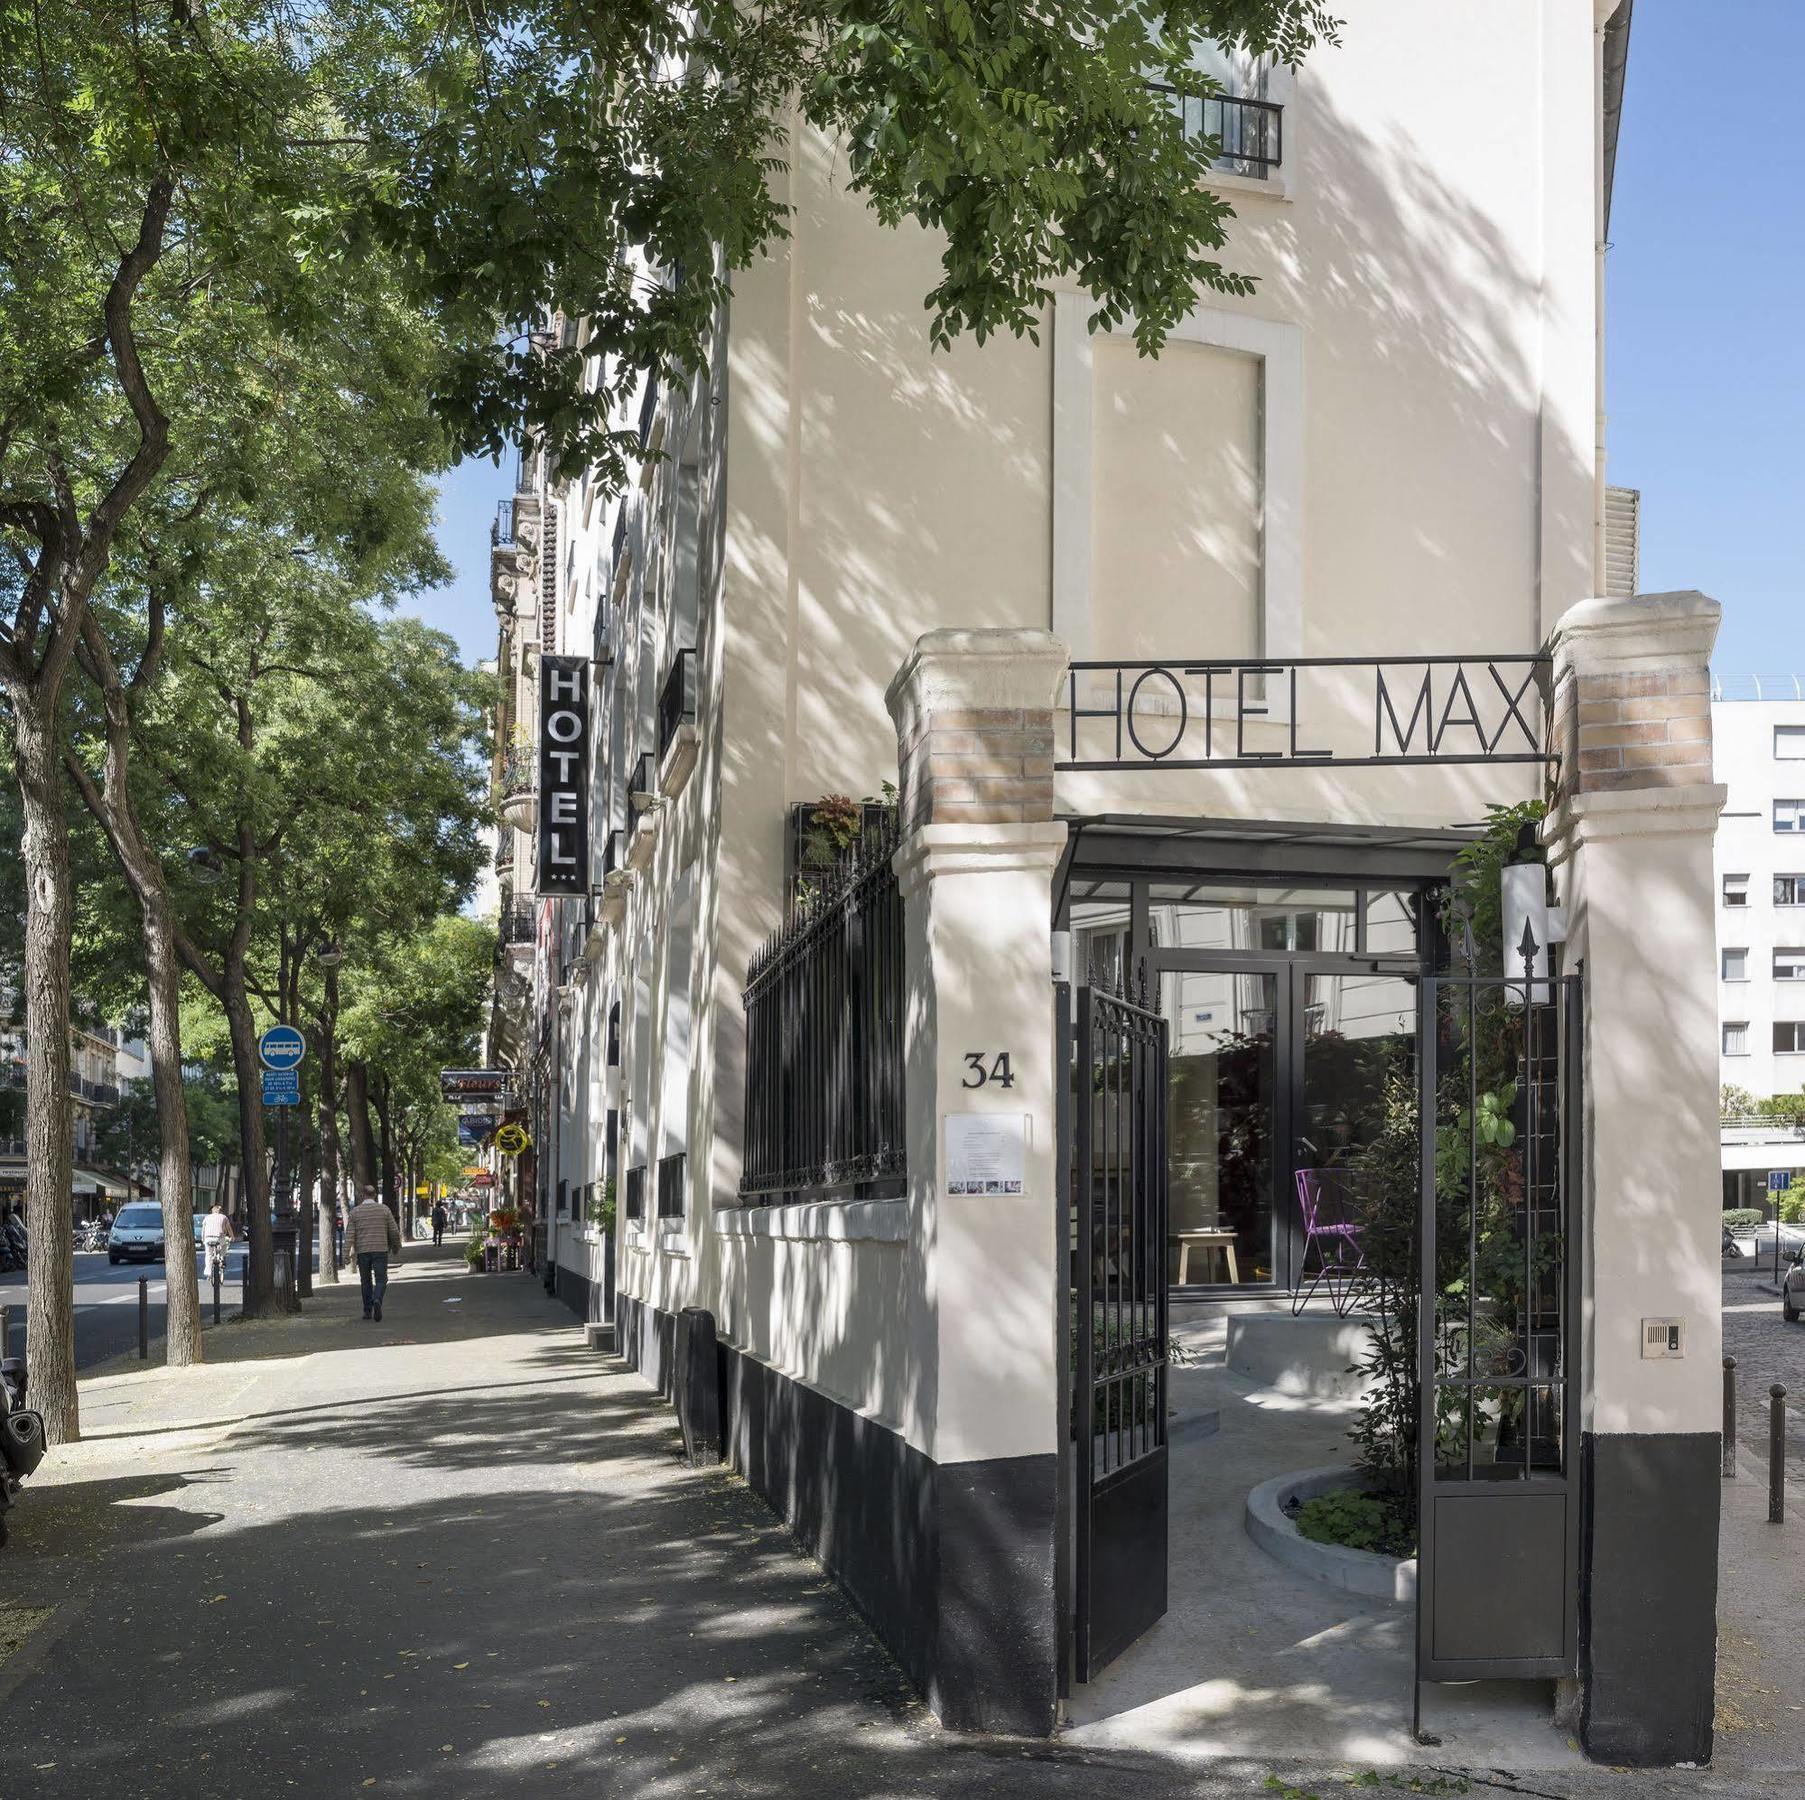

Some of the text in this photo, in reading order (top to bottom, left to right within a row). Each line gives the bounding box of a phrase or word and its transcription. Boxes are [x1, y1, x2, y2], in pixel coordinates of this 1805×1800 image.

[1071, 662, 1540, 759] HOTEL MAX
[547, 669, 583, 865] HOTEL
[962, 1052, 1015, 1089] 34
